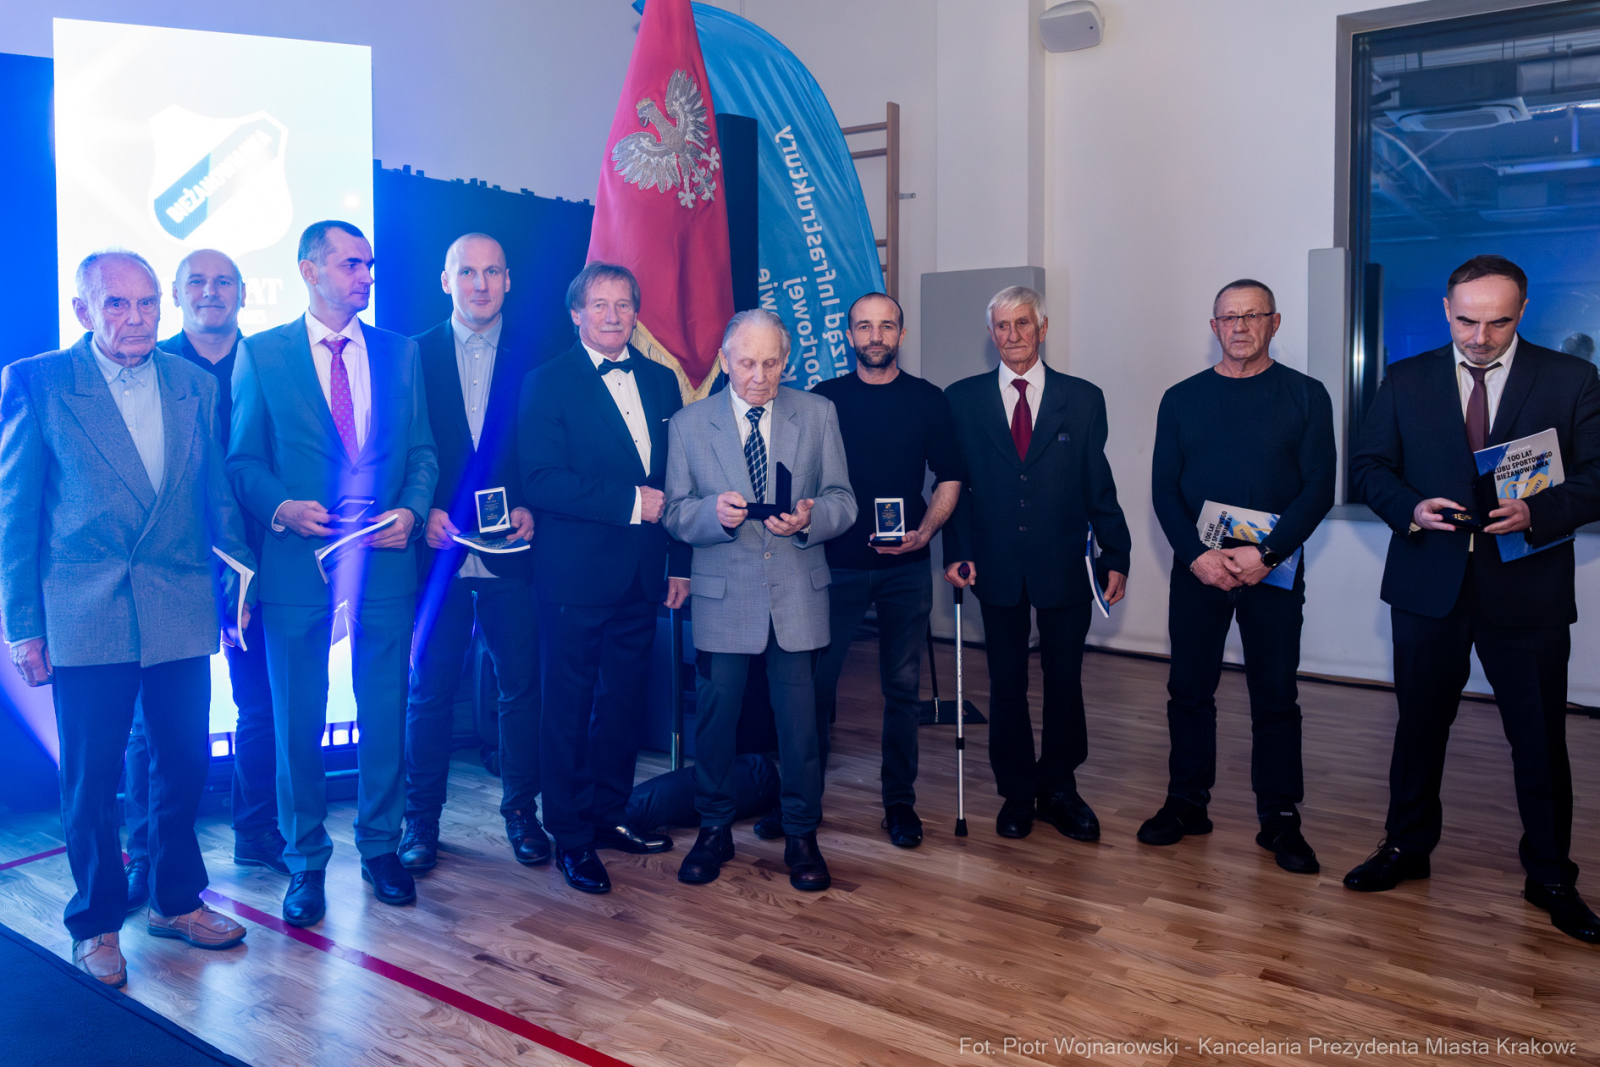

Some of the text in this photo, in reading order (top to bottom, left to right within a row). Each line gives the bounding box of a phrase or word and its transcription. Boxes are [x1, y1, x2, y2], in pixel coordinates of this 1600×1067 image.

[245, 278, 284, 305] AT
[1507, 450, 1533, 462] 100 LAT
[1512, 451, 1553, 469] SPORTOWEGO
[1496, 460, 1550, 481] BIEŻANOWIANKA
